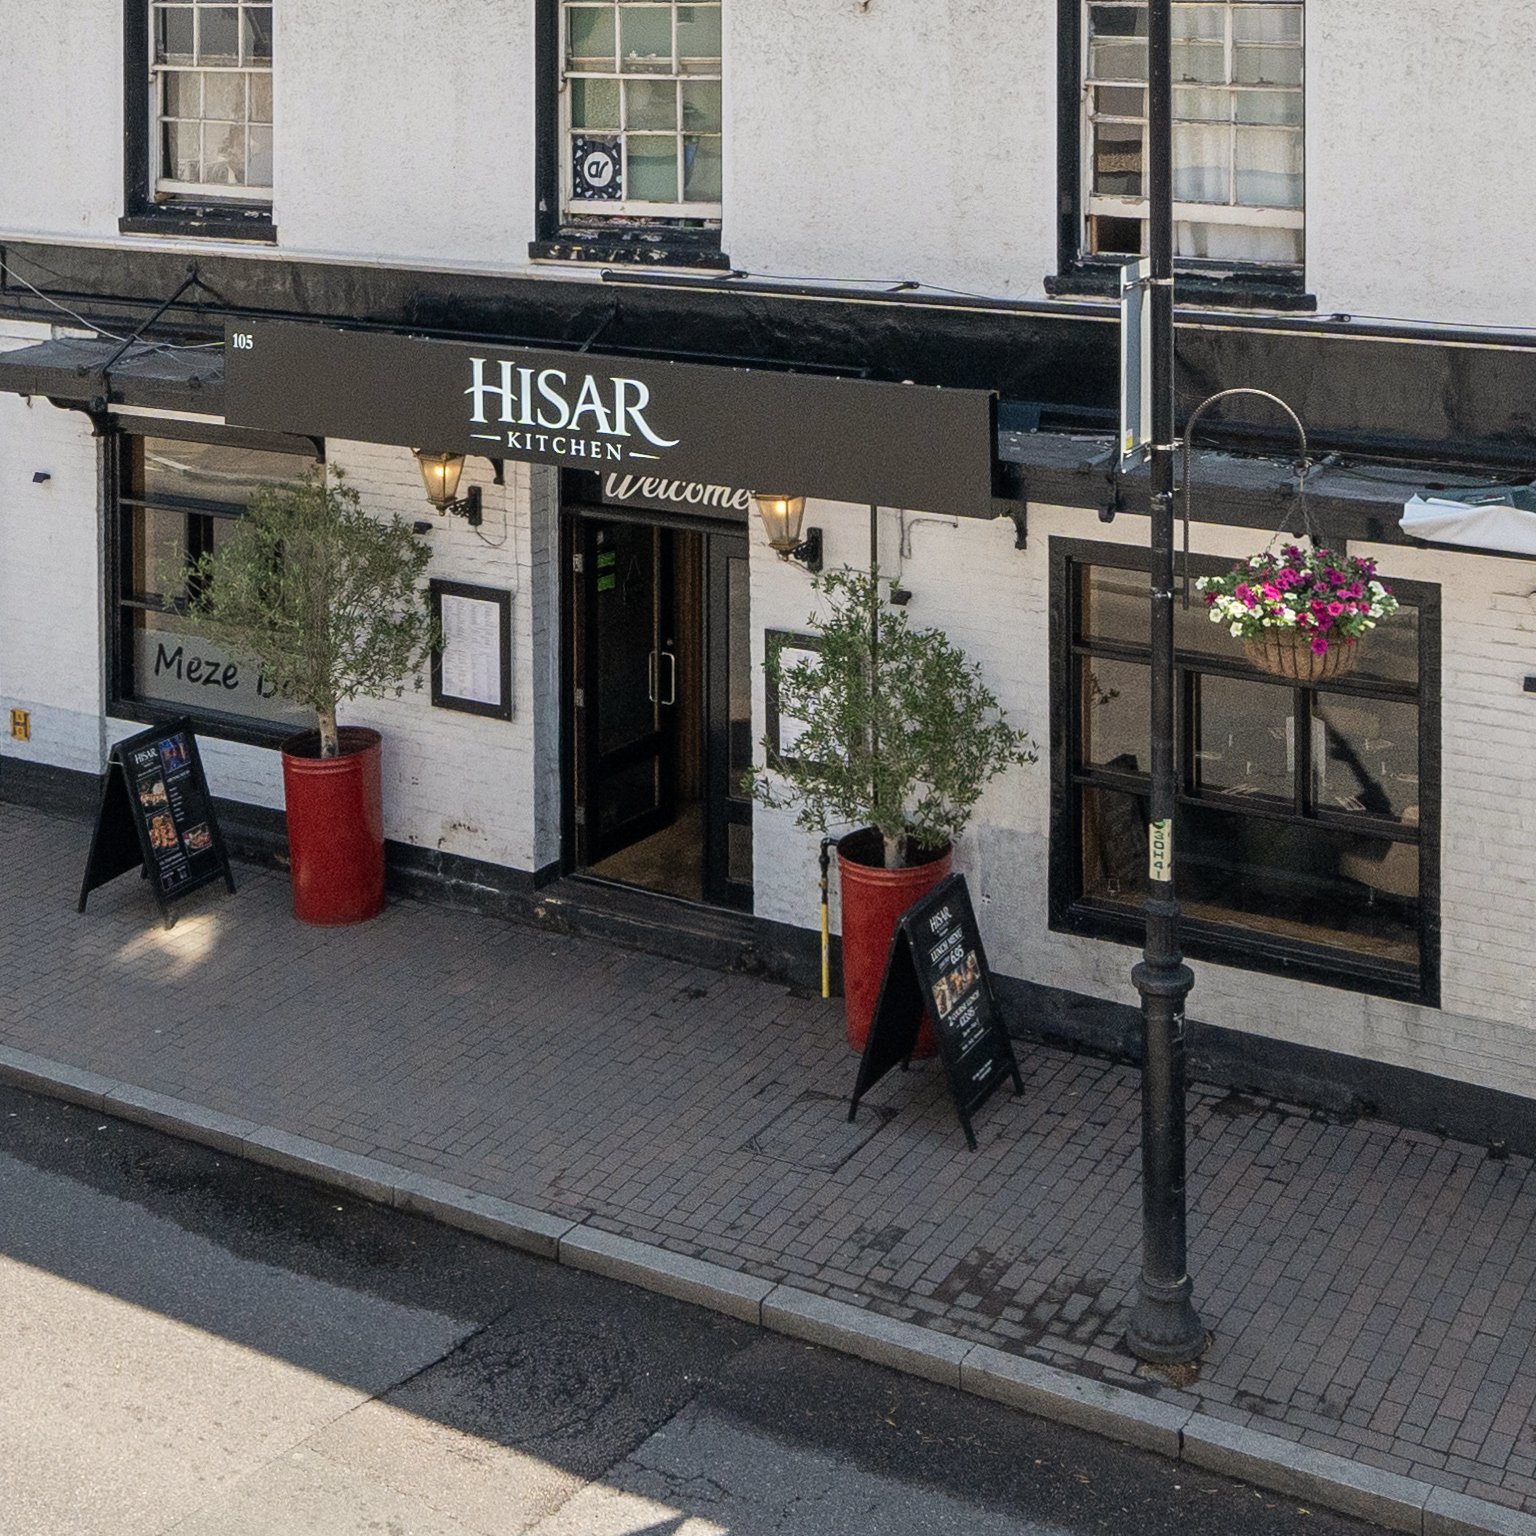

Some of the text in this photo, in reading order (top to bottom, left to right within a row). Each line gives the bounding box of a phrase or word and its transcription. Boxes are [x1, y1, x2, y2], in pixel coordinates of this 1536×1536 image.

[232, 333, 254, 350] 105
[464, 357, 680, 447] HISAR
[507, 431, 622, 461] KITCHEN
[154, 643, 239, 690] Meze
